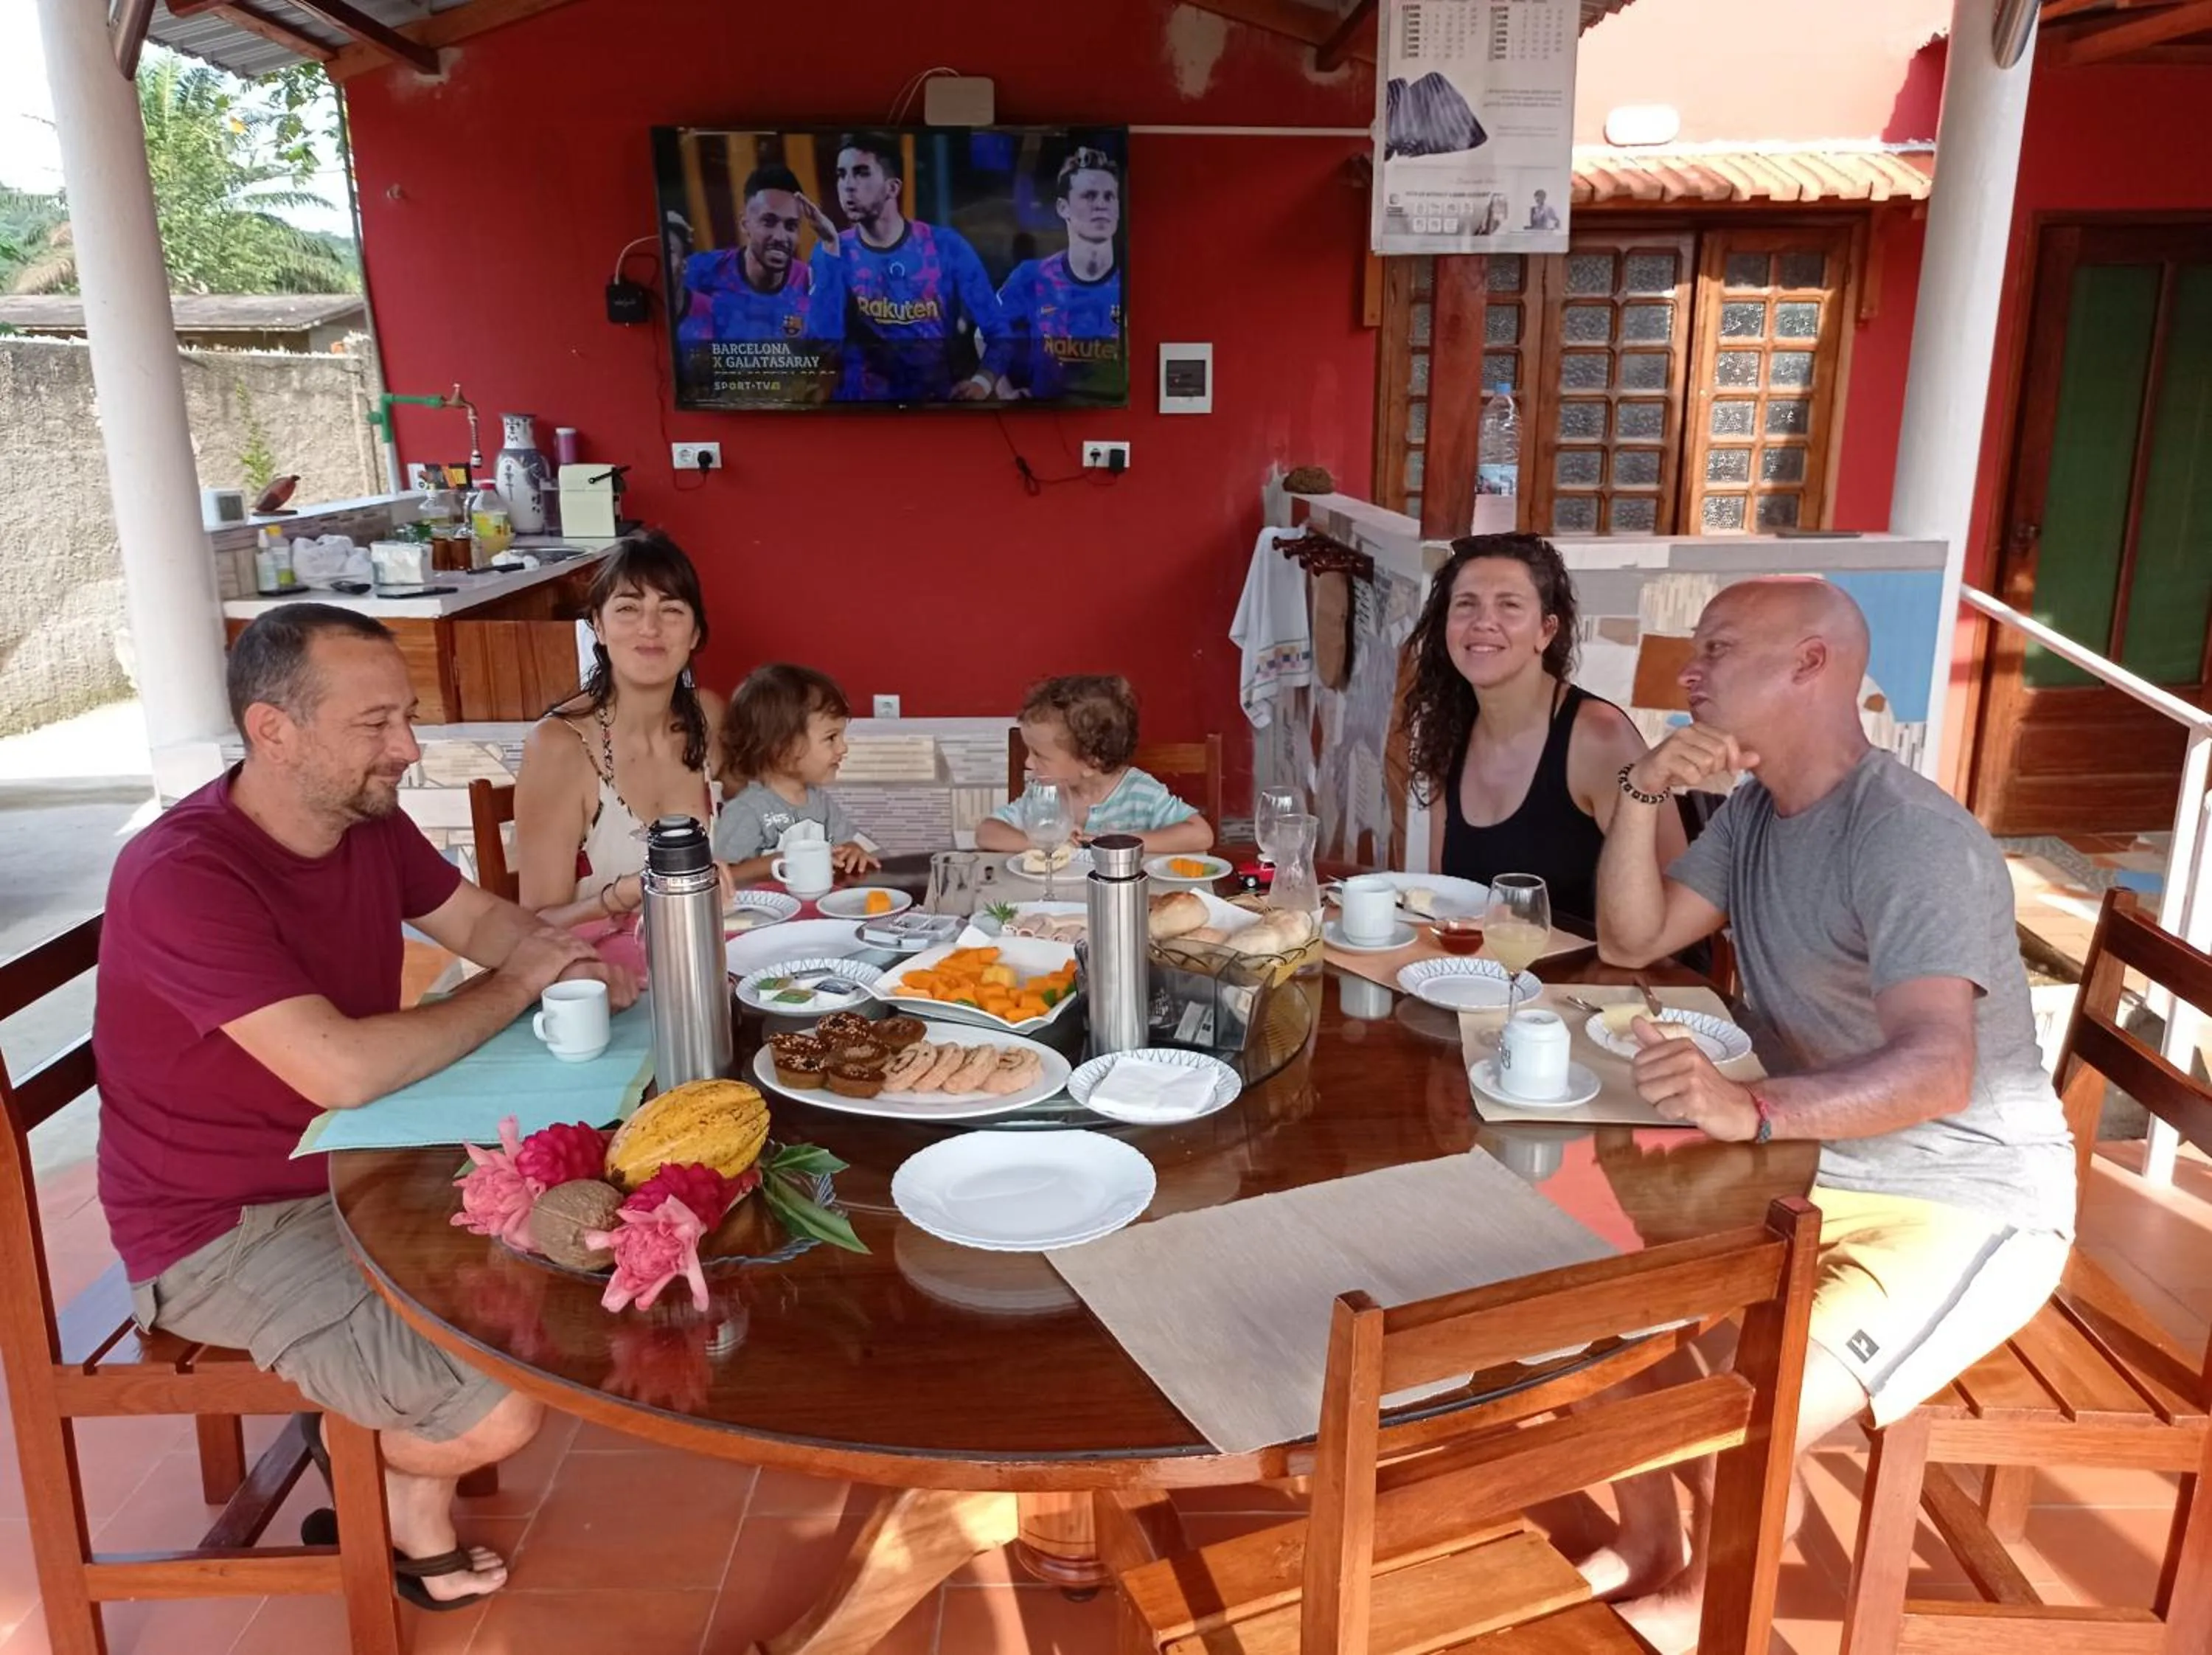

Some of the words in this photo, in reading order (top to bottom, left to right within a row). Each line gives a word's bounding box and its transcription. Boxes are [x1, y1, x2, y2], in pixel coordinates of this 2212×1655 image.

[857, 296, 940, 320] Rakuten
[712, 343, 791, 355] BARCELONA
[1044, 333, 1119, 359] Rakute
[712, 356, 723, 368] X
[726, 356, 820, 368] GALATASARAY
